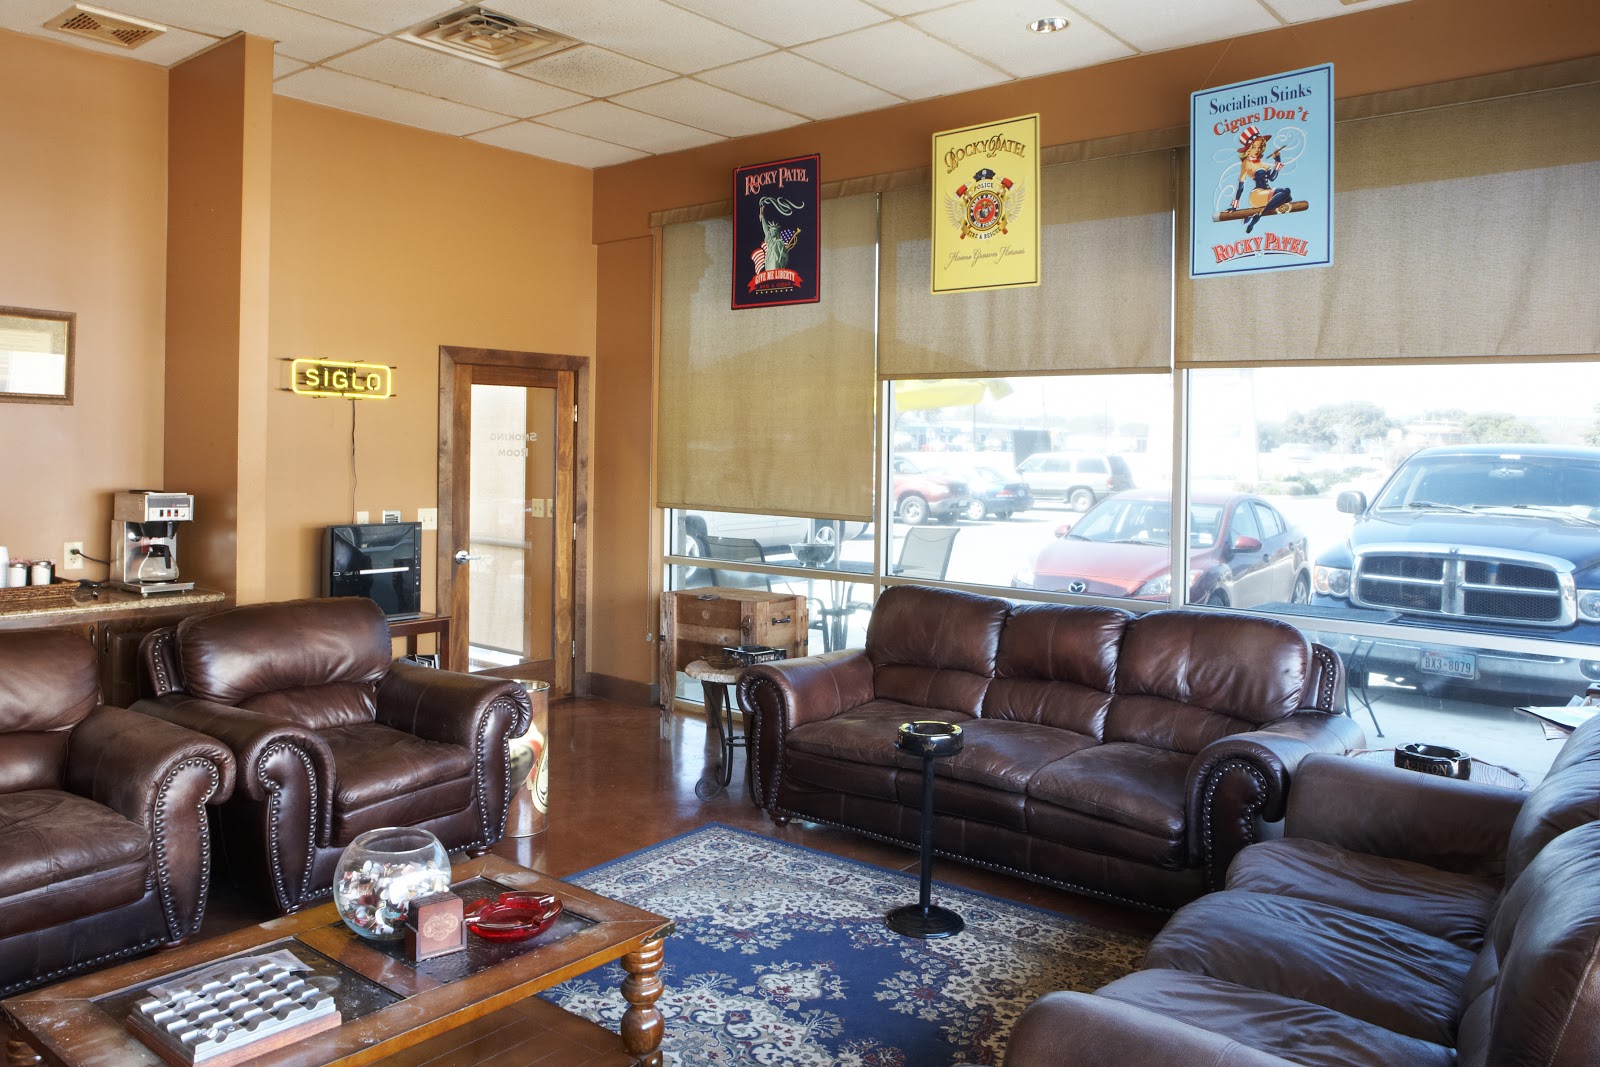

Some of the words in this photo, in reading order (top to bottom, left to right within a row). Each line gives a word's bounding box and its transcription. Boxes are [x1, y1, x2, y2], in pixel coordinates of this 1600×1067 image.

[1209, 94, 1268, 116] Socialism
[1270, 83, 1312, 103] Stinks
[1213, 112, 1260, 135] Cigars
[1263, 106, 1309, 122] Don't
[944, 139, 989, 174] ROCKY
[987, 133, 1026, 158] PATEL
[745, 170, 778, 196] ROCKY
[778, 167, 809, 188] PATEL
[973, 182, 994, 191] POLICE
[944, 251, 972, 270] Home
[971, 248, 998, 267] Grown
[1212, 236, 1263, 264] ROCKY
[1263, 232, 1309, 256] PATEL
[755, 272, 767, 285] GIVE
[767, 270, 775, 281] ME
[775, 270, 796, 282] LIBERTY
[305, 368, 382, 391] SIGLO
